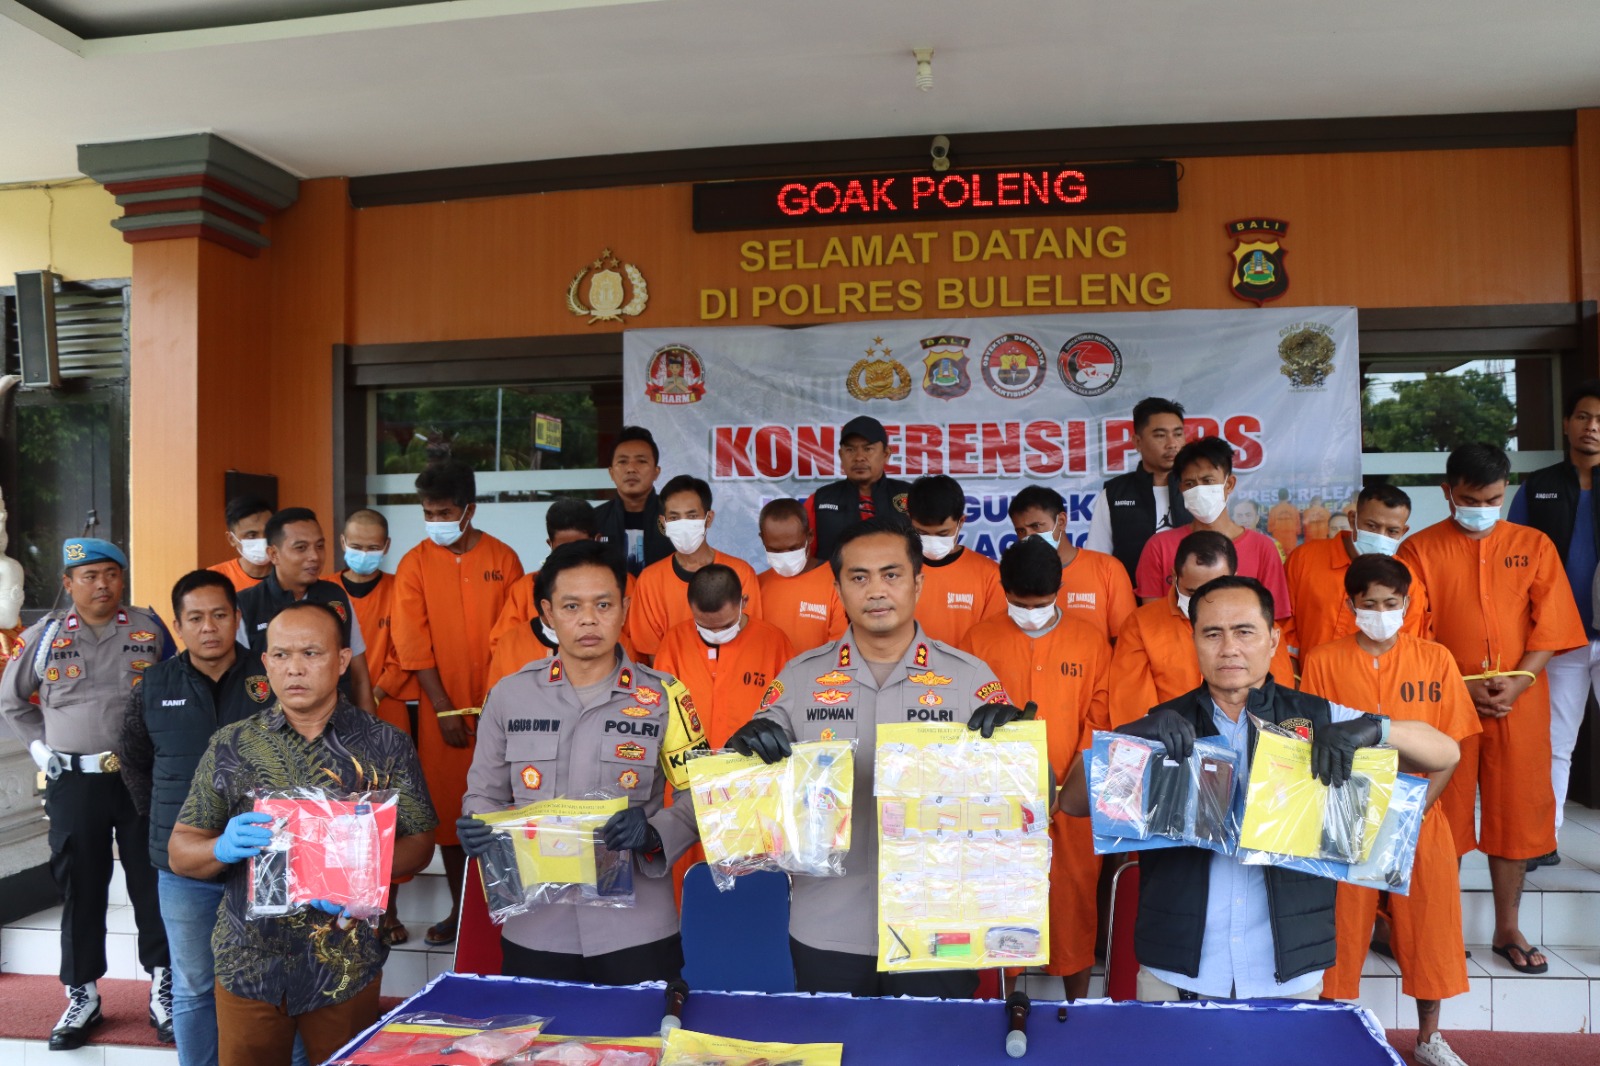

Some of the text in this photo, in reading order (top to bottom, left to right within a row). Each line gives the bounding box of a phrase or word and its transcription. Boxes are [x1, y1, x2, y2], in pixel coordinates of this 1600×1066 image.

[777, 170, 1088, 215] GOAK POLENG
[1236, 221, 1279, 231] BALI
[739, 225, 1127, 272] SELAMAT DATANG
[700, 272, 1172, 319] DI POLRES BULELENG
[926, 338, 965, 346] BALI
[1014, 335, 1045, 365] DIPERCAYA
[655, 393, 697, 403] DHARMA
[715, 415, 1264, 477] KONERENSI PS
[1504, 555, 1529, 568] 073
[1060, 662, 1083, 678] 051
[743, 672, 766, 687] 075
[1400, 680, 1442, 703] 016
[162, 699, 187, 707] KANIT
[806, 708, 854, 721] WIDWAN
[907, 708, 953, 722] POLRI
[508, 719, 560, 732] AGUS DWI W
[604, 719, 660, 738] POLRI
